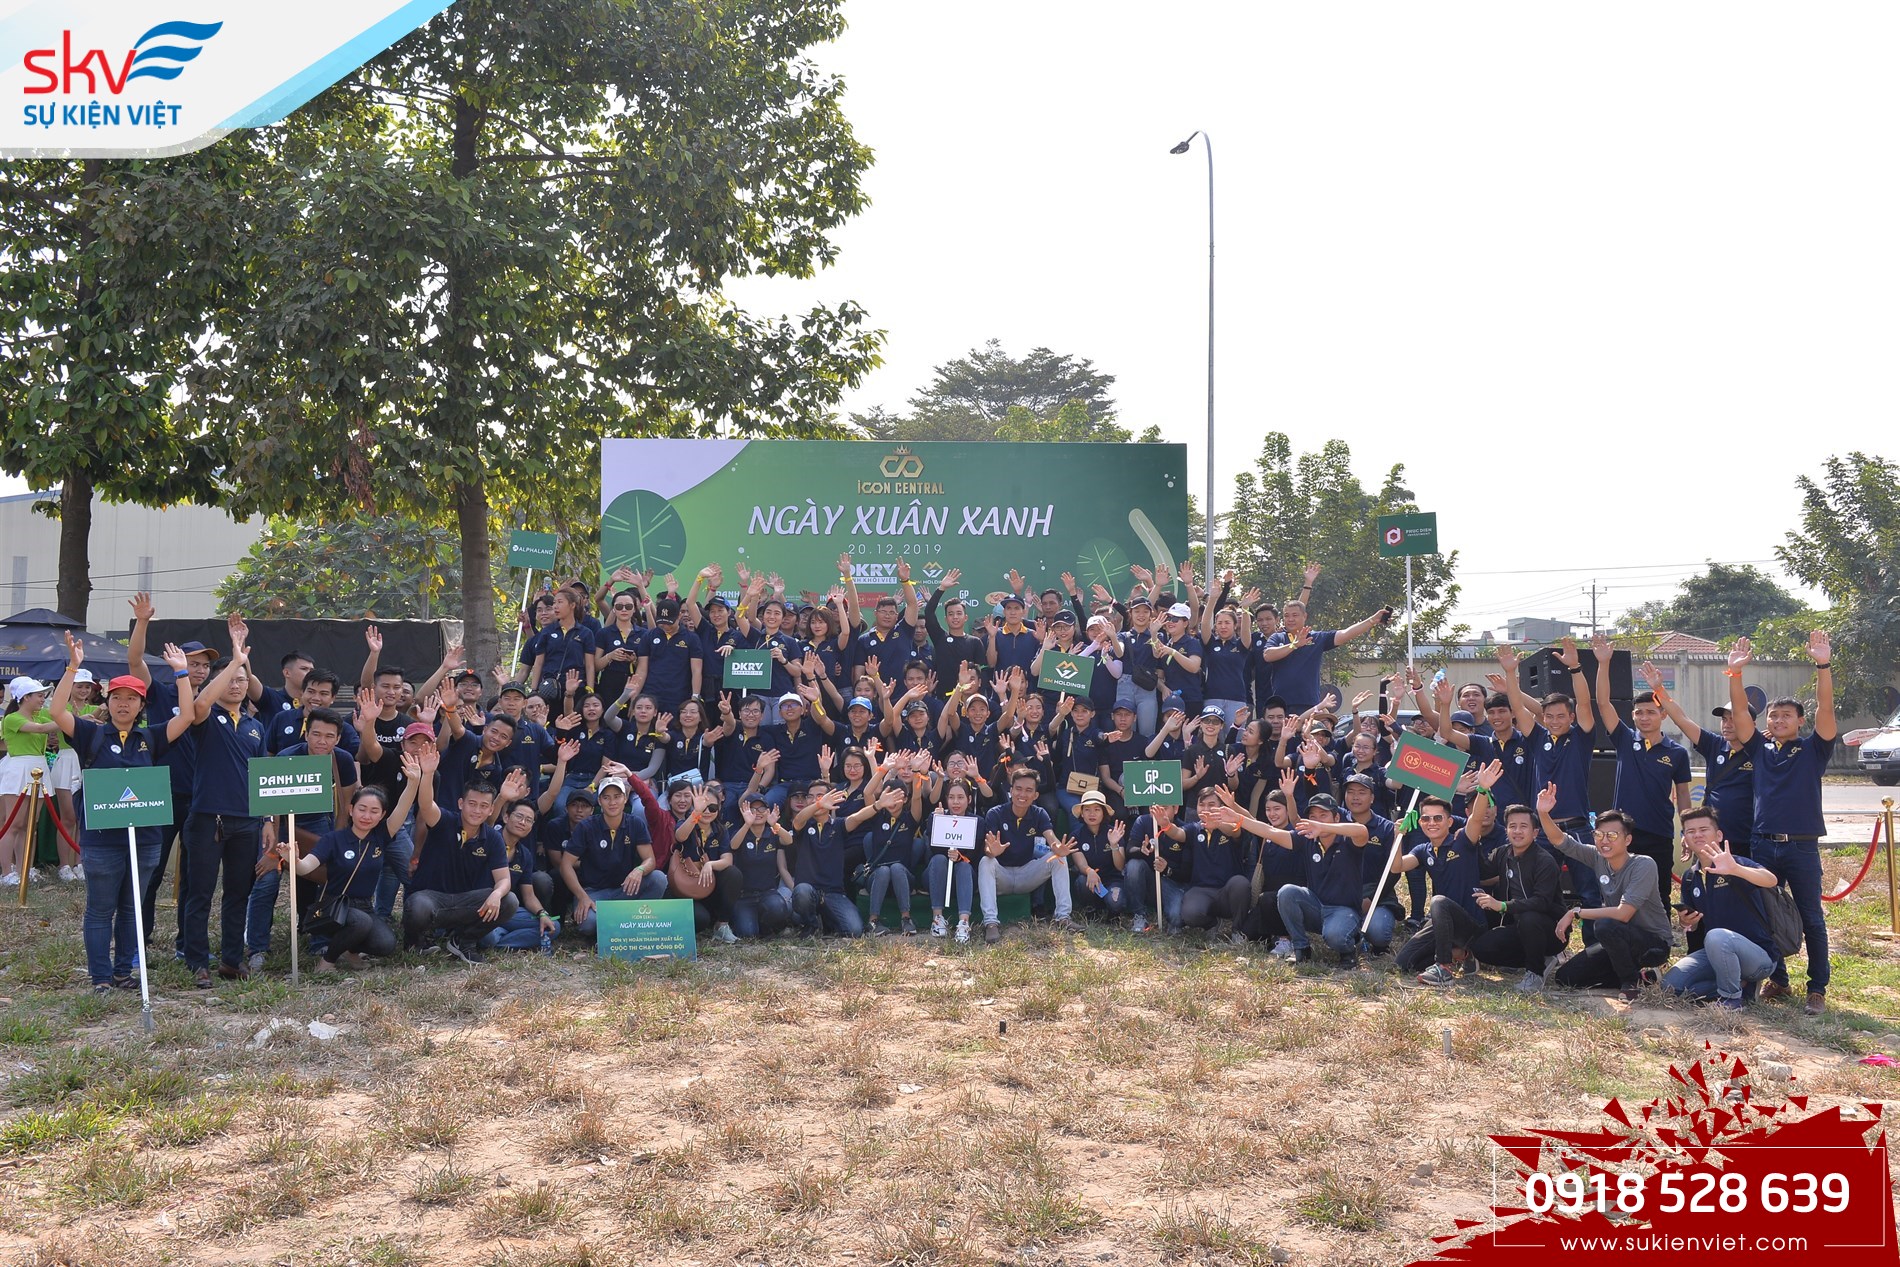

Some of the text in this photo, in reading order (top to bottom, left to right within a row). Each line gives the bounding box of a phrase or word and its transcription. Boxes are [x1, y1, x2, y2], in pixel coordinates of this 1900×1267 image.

[895, 482, 945, 495] CENTRAL
[748, 498, 1054, 538] NGÀY XUÂN XANH
[519, 546, 553, 555] ALPHALAND
[848, 544, 942, 555] 20.12.2019
[960, 599, 979, 607] ND
[732, 662, 763, 671] DKRV
[1054, 680, 1086, 689] HOLDINGS
[376, 734, 393, 742] das
[1422, 761, 1441, 771] QUEEN
[1441, 768, 1451, 776] SEA
[259, 773, 322, 785] DANH VIET
[1145, 770, 1159, 783] GP
[1133, 783, 1174, 794] LAND
